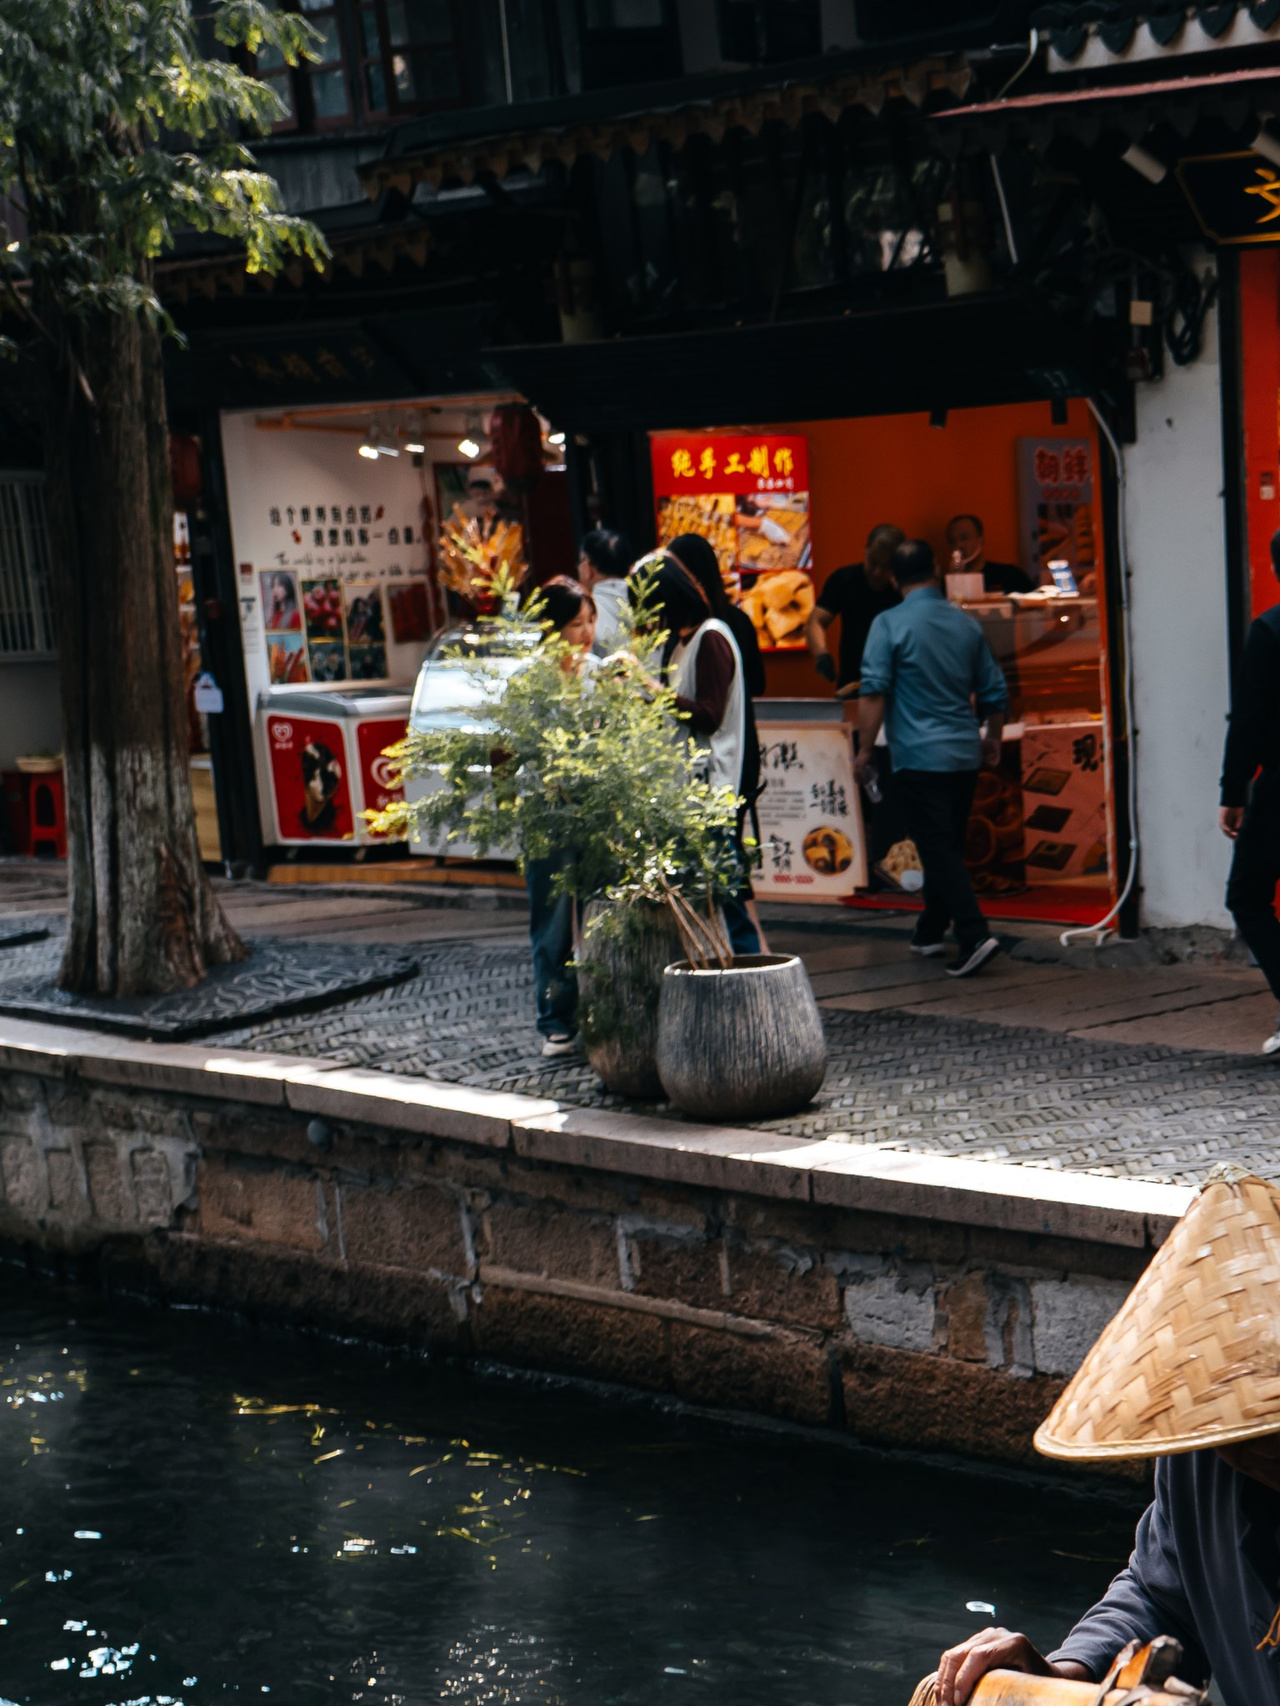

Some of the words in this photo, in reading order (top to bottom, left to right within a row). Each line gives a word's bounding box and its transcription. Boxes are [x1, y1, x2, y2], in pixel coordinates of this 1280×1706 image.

[671, 445, 794, 480] 纯手工制作
